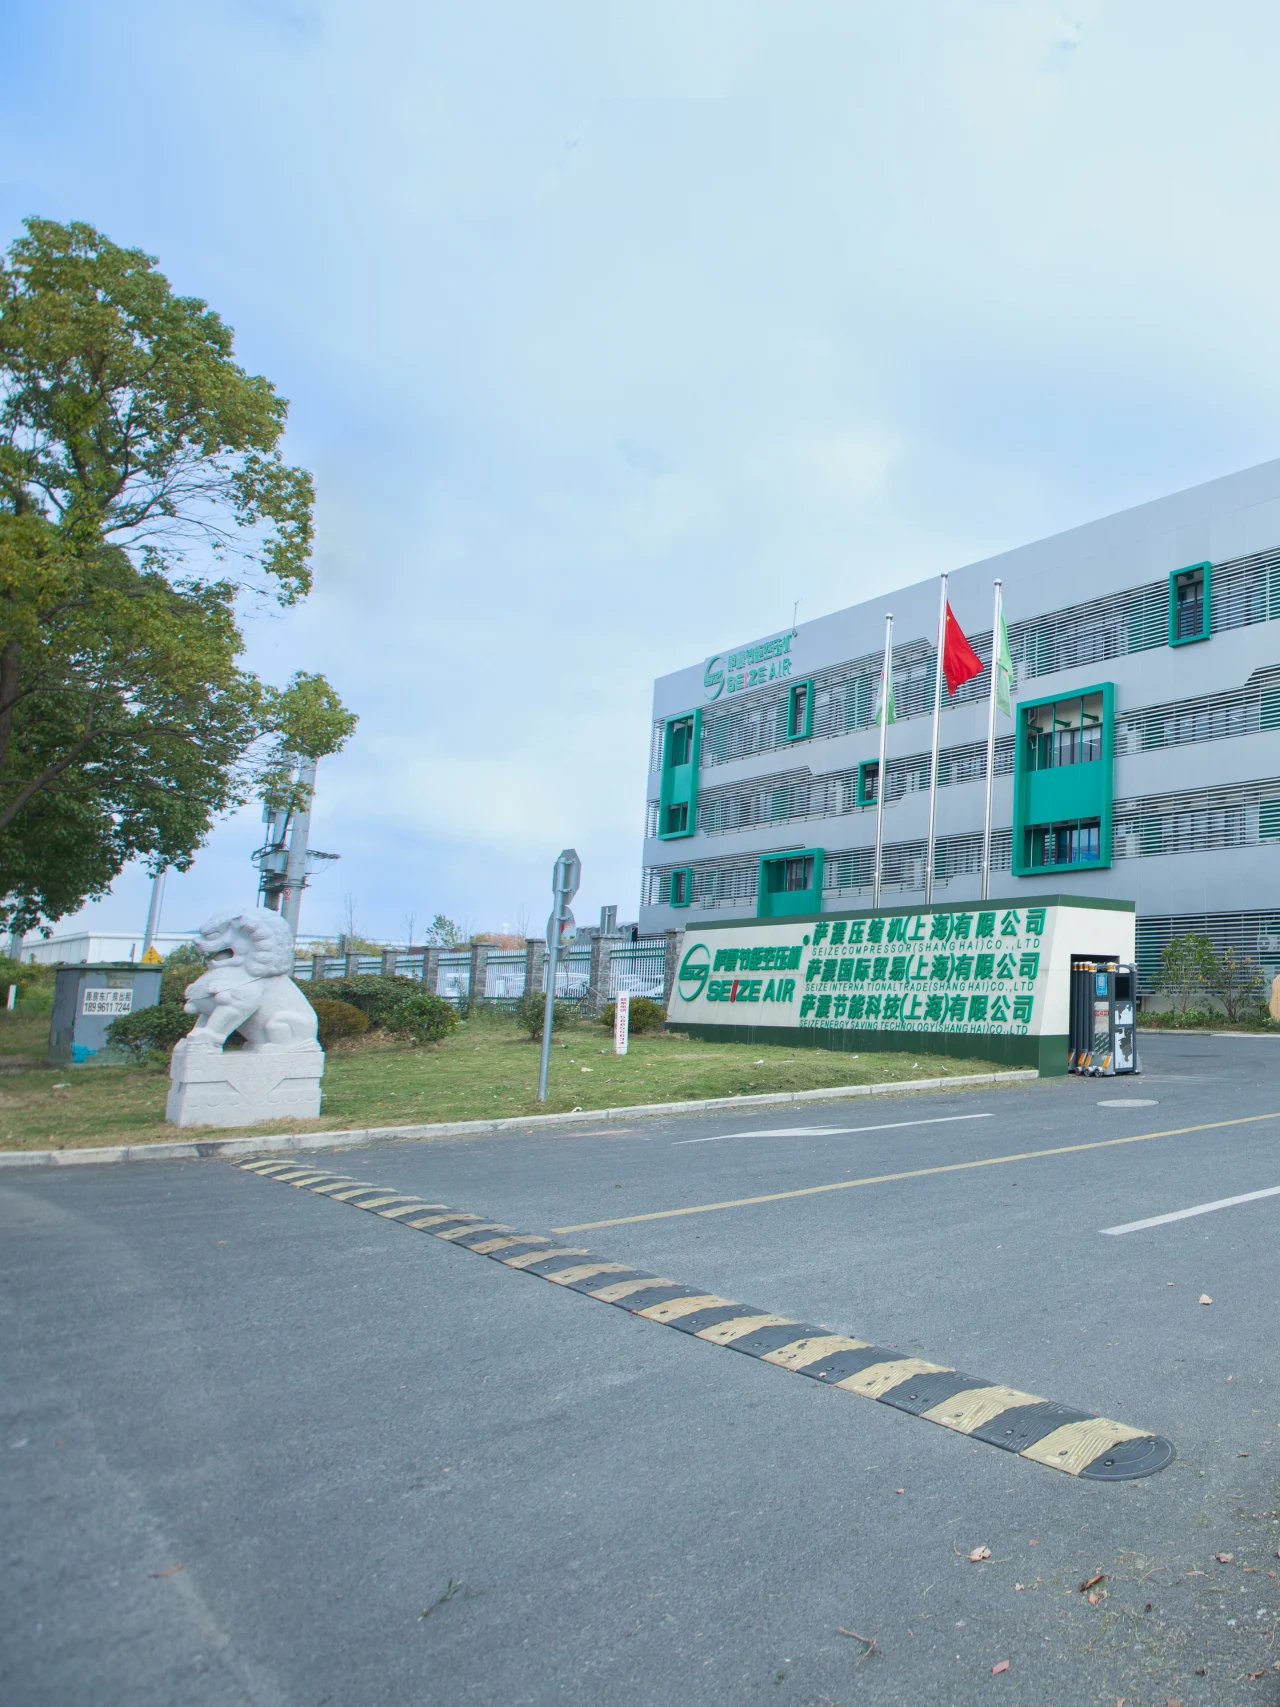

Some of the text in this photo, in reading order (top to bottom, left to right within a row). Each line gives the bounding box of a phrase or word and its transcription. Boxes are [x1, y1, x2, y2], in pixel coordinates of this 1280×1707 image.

[726, 657, 792, 693] SEIZE AIR
[812, 908, 1046, 945] 萨震压缩机(上海)有限公司
[713, 946, 803, 971] 萨震节能空压机
[812, 946, 839, 956] SEIZE
[805, 952, 1040, 983] 萨震国际贸易(上海)有限公司
[707, 979, 796, 1002] SEIZE AIR
[806, 983, 828, 992] SEIZE
[799, 993, 1034, 1024] 萨震节能科技(上海)有限公司
[800, 1019, 819, 1028] SEIZE
